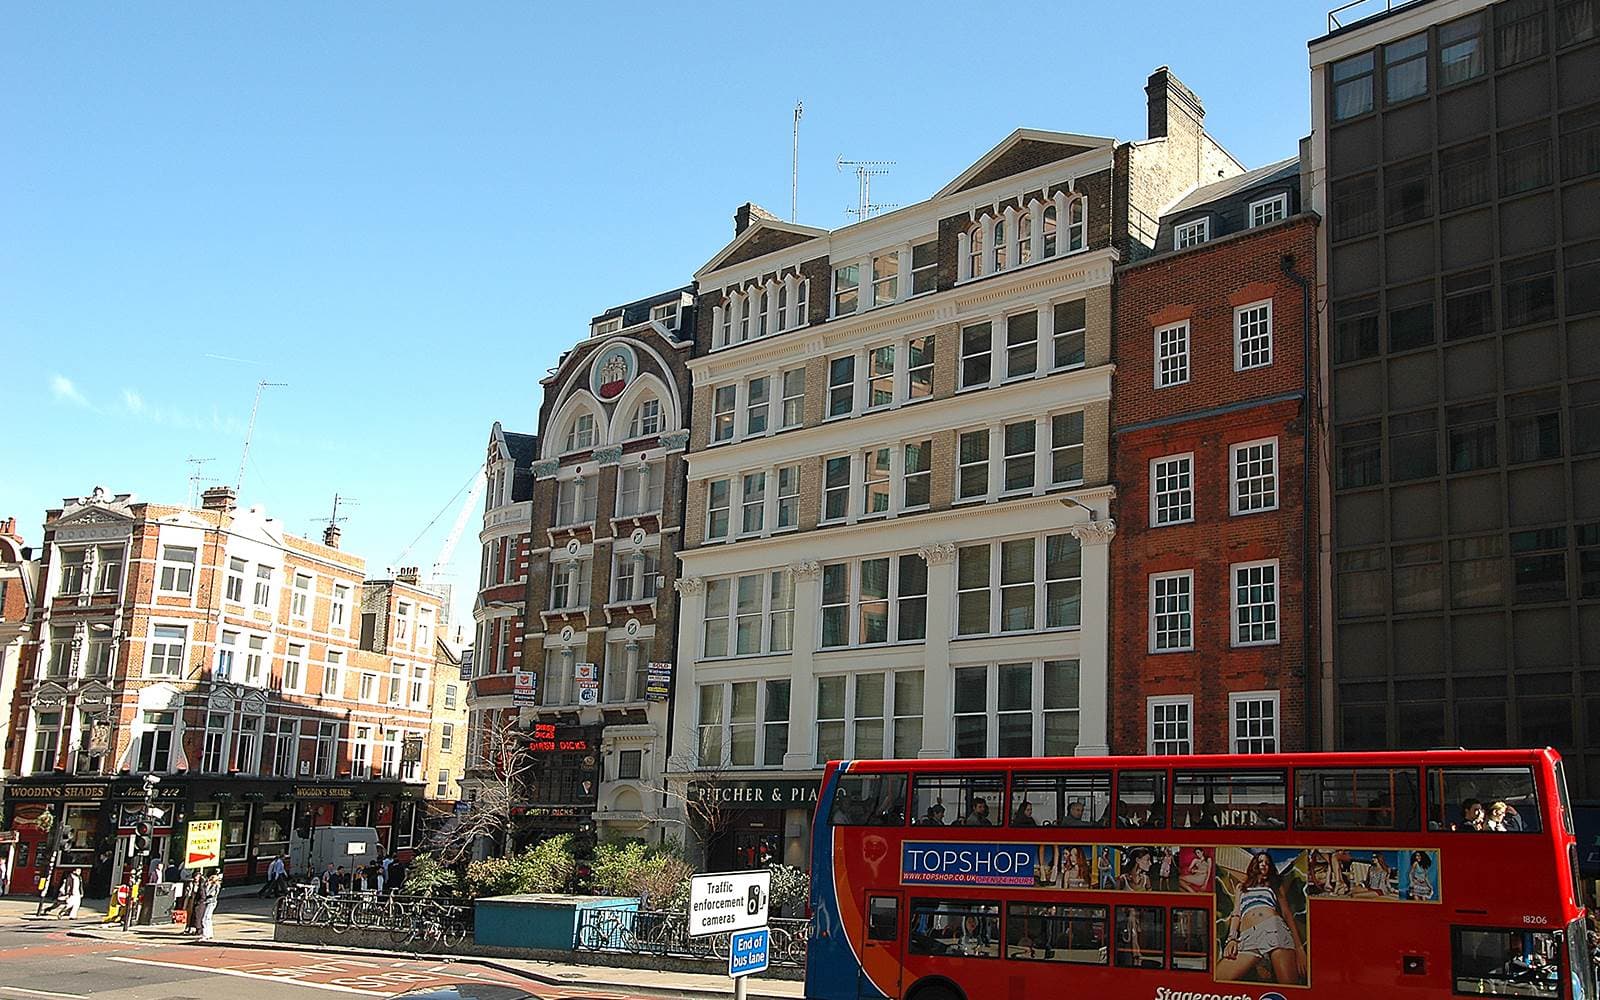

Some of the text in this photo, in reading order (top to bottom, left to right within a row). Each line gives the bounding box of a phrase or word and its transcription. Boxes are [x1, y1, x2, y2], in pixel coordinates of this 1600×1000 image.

[560, 740, 586, 750] DICKS
[11, 787, 104, 798] WOODIN'S SHADES
[699, 788, 764, 801] PITCHER
[771, 788, 782, 801] &
[907, 850, 1030, 873] TOPSHOP
[707, 881, 733, 894] Traffic
[693, 897, 744, 911] enforcement
[701, 914, 736, 927] cameras
[1523, 915, 1547, 924] 18206
[737, 935, 763, 952] End of
[733, 952, 765, 967] bus lane
